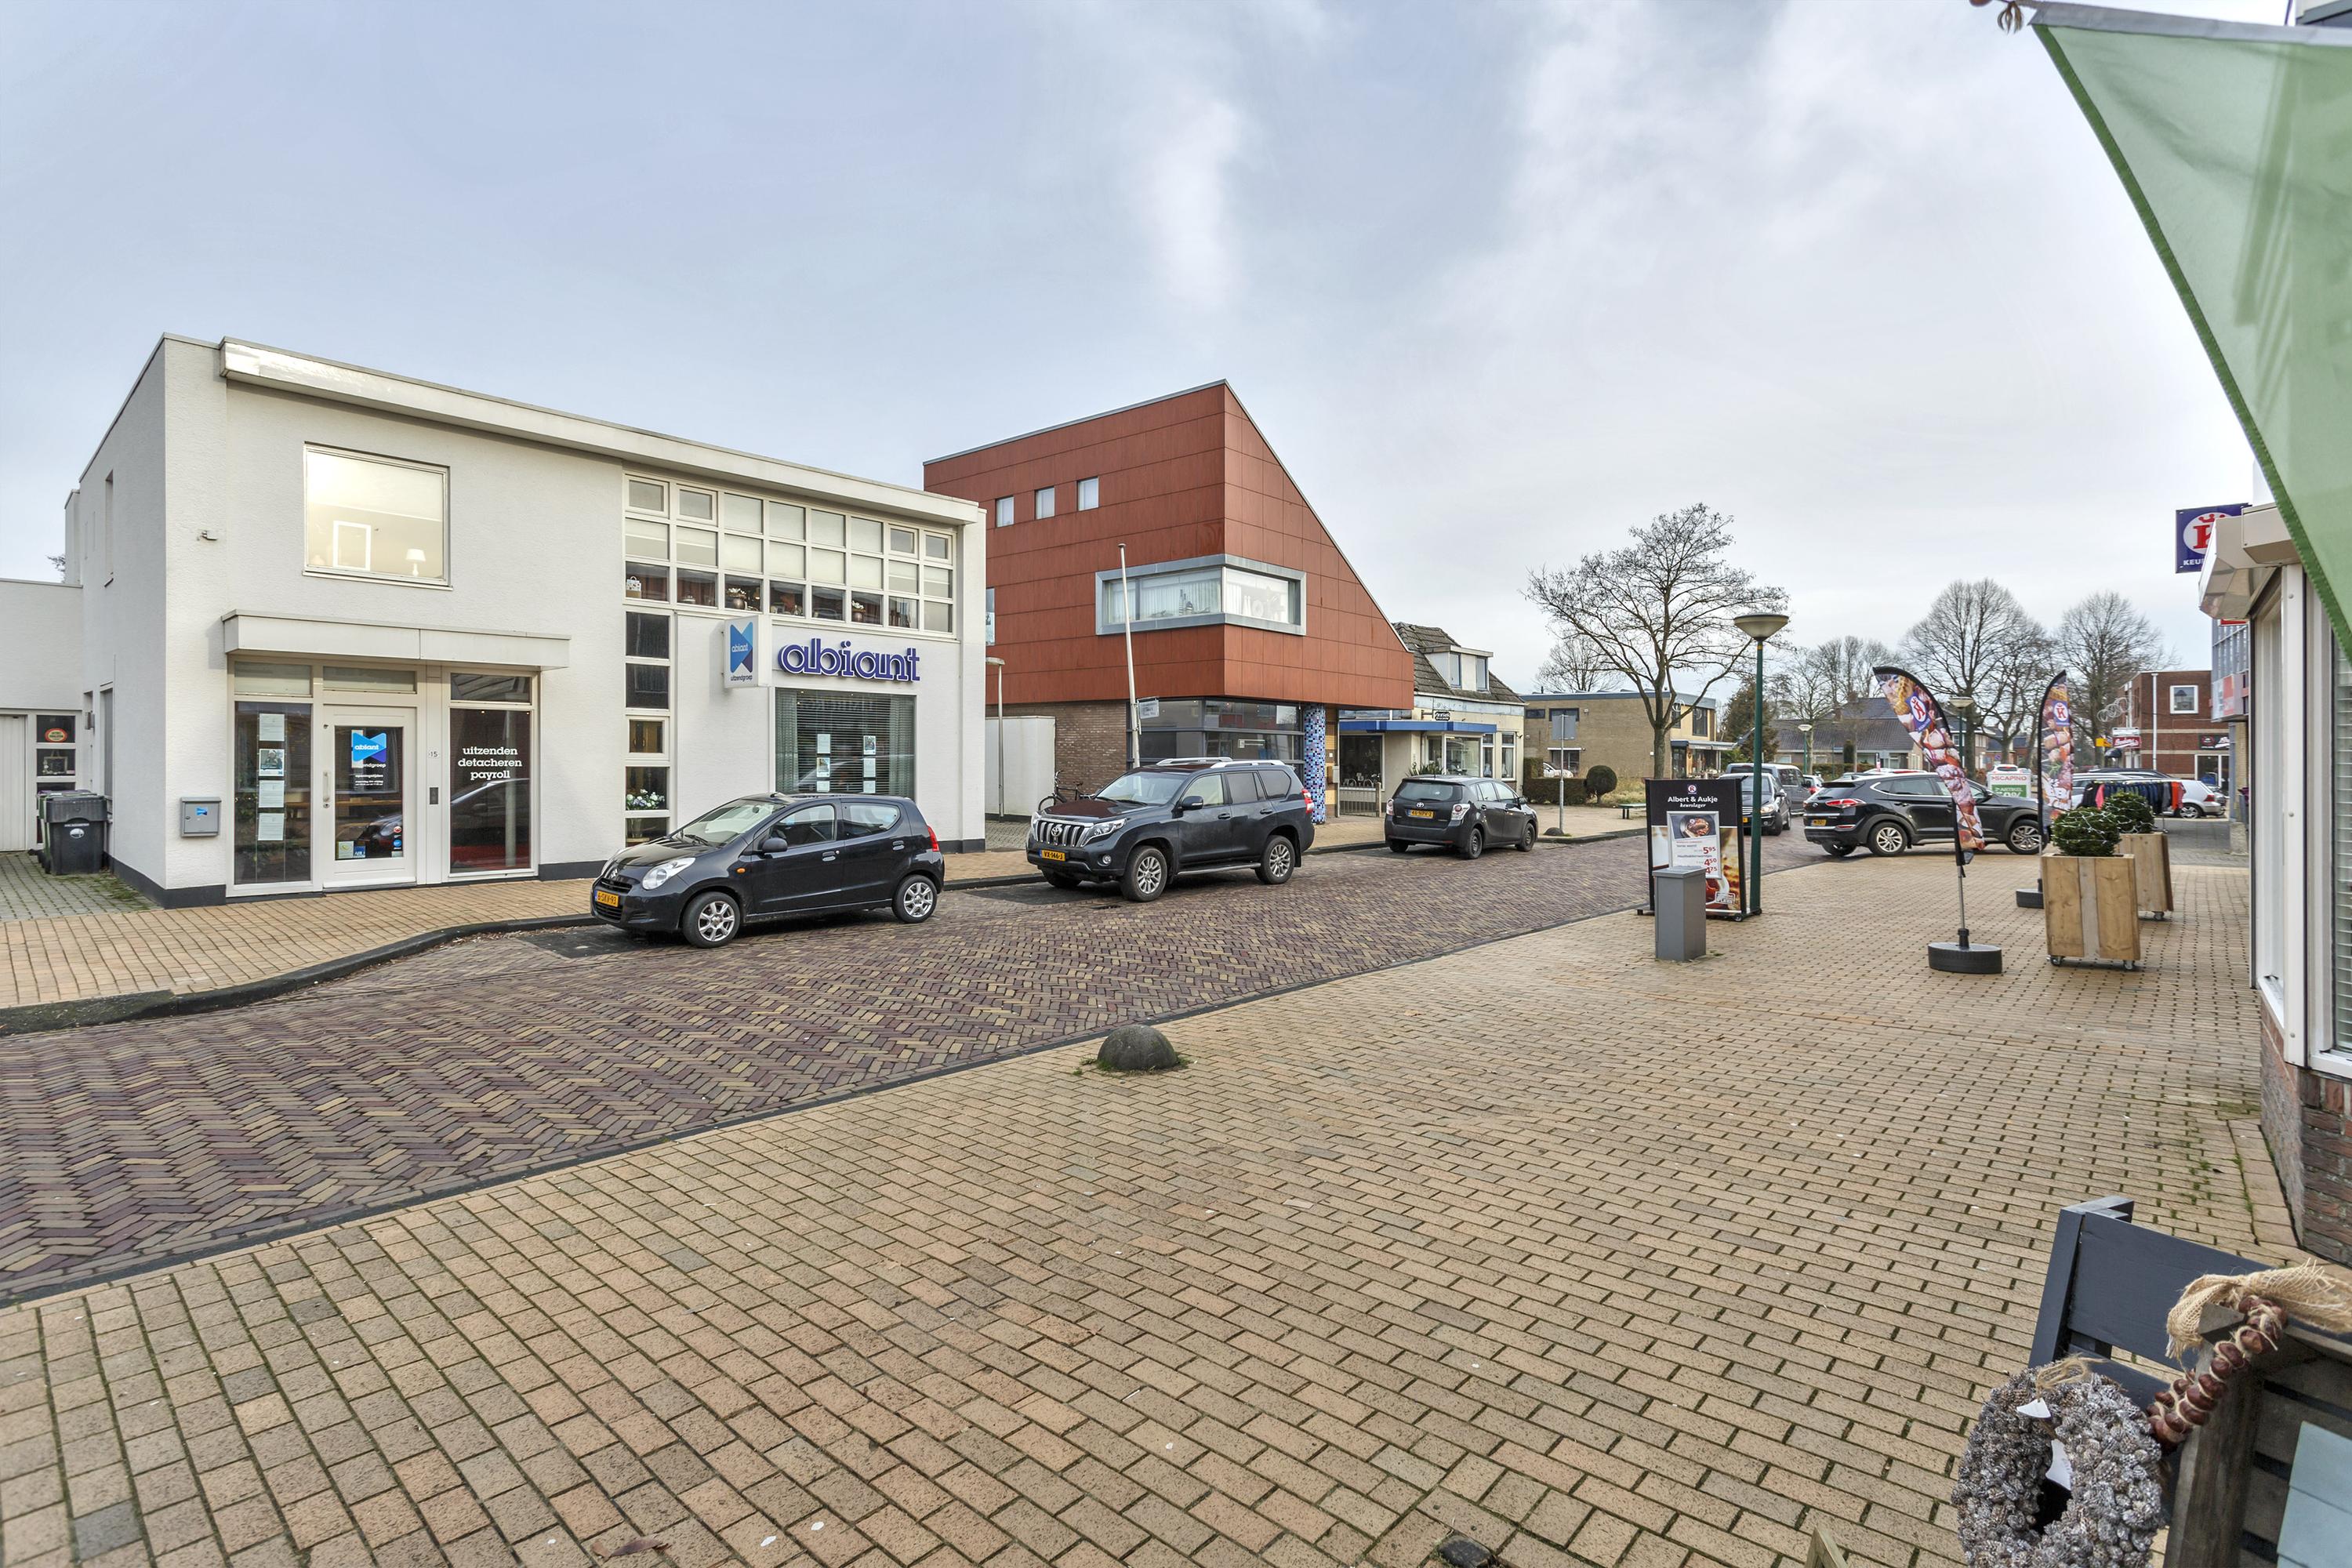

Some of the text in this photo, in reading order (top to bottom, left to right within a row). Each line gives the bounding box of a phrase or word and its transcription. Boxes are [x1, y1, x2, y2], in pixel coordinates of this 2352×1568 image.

[731, 644, 749, 652] abiant
[778, 637, 920, 682] abiant
[463, 746, 518, 756] uitzenden
[457, 758, 523, 768] detacheren
[470, 770, 510, 781] payroll
